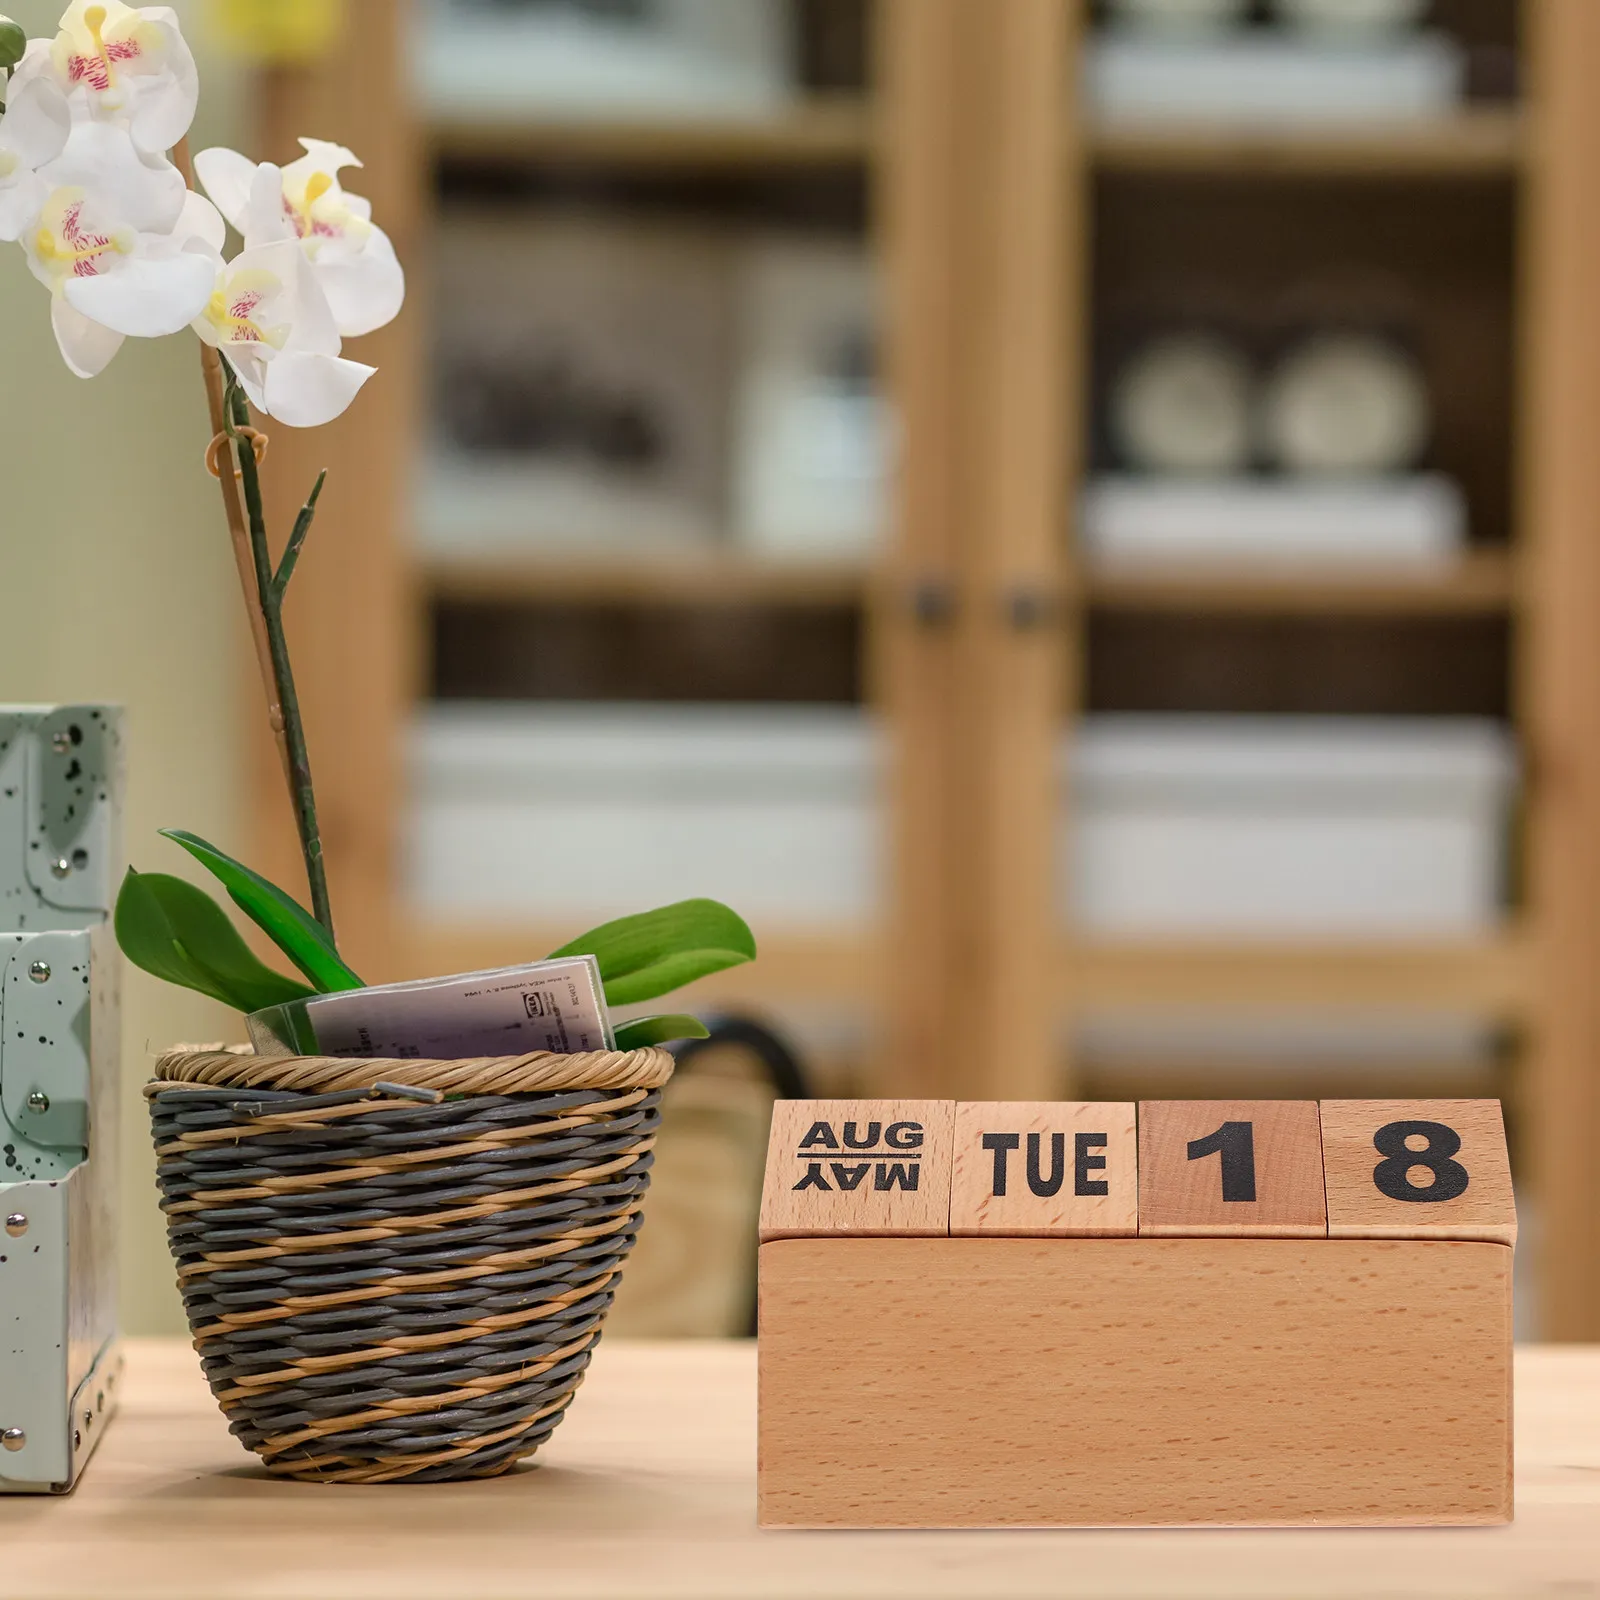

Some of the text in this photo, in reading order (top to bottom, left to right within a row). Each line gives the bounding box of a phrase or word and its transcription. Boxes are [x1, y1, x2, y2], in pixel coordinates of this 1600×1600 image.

[800, 1121, 924, 1150] AUG
[982, 1132, 1109, 1197] TUE
[1187, 1121, 1257, 1203] 1
[1373, 1120, 1470, 1203] 8
[791, 1161, 920, 1192] MAY
